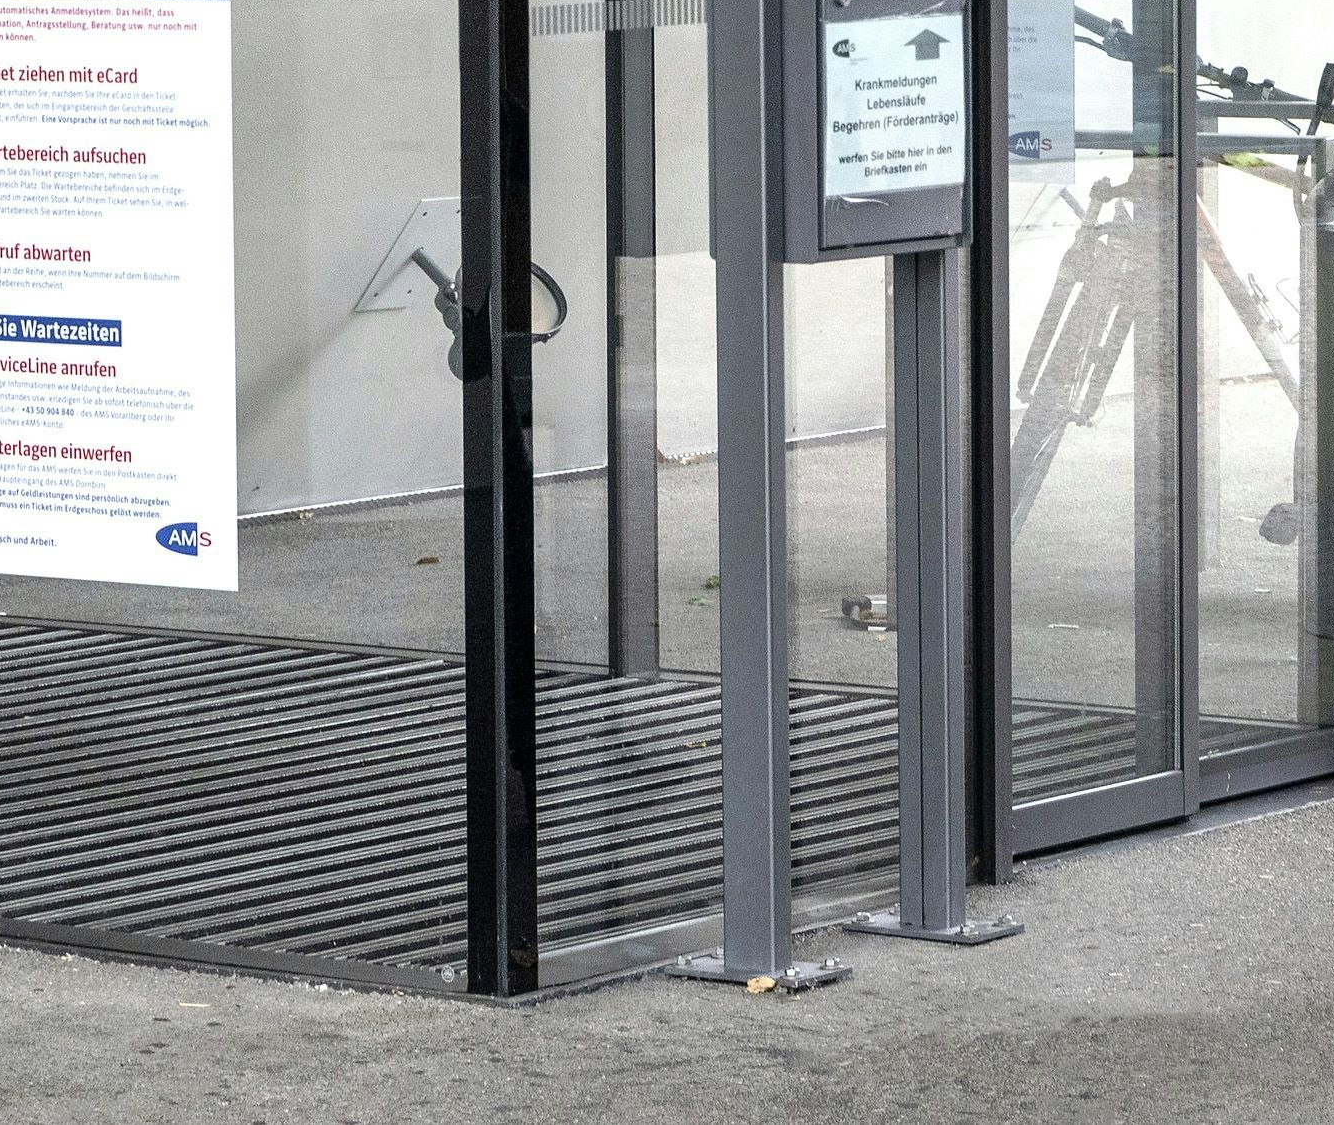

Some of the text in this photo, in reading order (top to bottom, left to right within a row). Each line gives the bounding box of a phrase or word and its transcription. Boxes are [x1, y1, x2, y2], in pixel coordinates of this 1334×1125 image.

[116, 8, 130, 16] Das
[157, 9, 175, 17] dass
[91, 21, 126, 32] Beratung
[163, 22, 182, 31] noch
[184, 22, 197, 31] mit
[838, 42, 856, 54] AMS
[18, 66, 65, 82] ziehen
[69, 67, 93, 83] mit
[97, 68, 138, 84] eCard
[855, 74, 937, 92] Krankmeldungen
[867, 94, 926, 110] Lebensläufe
[58, 116, 96, 124] Vorsprache
[142, 118, 154, 126] mit
[156, 118, 177, 126] Ticket
[833, 111, 959, 134] Begehren (Förderanträge)
[1016, 138, 1052, 151] AMS
[73, 147, 147, 165] aufsuchen
[838, 144, 953, 165] werfen Sie bitte hier in den
[864, 161, 928, 179] Briefkasten ein
[23, 244, 91, 262] abwarten
[21, 320, 120, 342] Wartezeiten
[61, 360, 116, 378] anrufen
[36, 407, 45, 415] 50
[47, 407, 60, 415] 904
[61, 408, 75, 416] 840
[61, 443, 132, 462] einwerfen
[8, 487, 19, 496] auf
[20, 487, 74, 501] Geldleistungen
[75, 492, 90, 501] sind
[92, 493, 129, 504] persönlich
[0, 501, 17, 509] muss
[19, 501, 30, 509] ein
[32, 502, 52, 511] Ticket
[54, 504, 63, 512] im
[65, 504, 108, 516] Erdgeschoss
[109, 507, 131, 517] gelöst
[13, 535, 28, 545] und
[30, 537, 57, 547] Arbeit.
[169, 529, 212, 547] AMS
